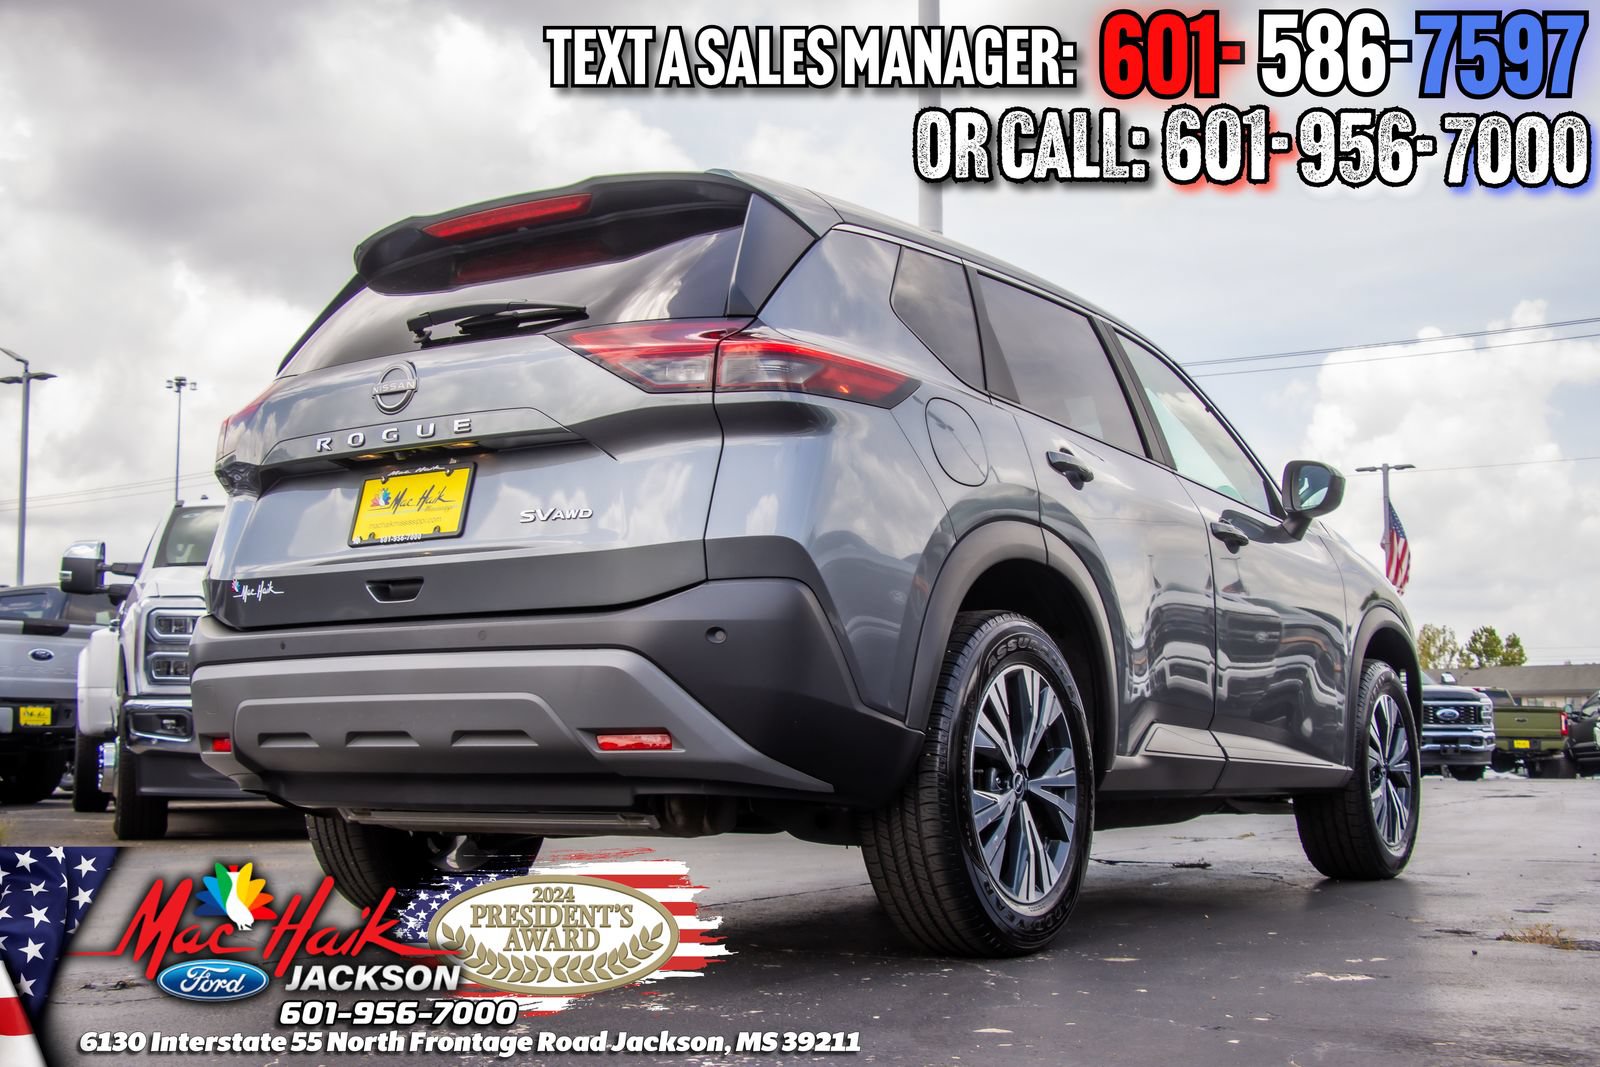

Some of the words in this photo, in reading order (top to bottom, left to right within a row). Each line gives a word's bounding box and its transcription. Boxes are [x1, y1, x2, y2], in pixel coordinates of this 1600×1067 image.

[373, 381, 415, 393] NISSAN
[316, 418, 473, 452] ROGUE
[369, 488, 415, 515] Mac
[416, 484, 456, 512] Haik
